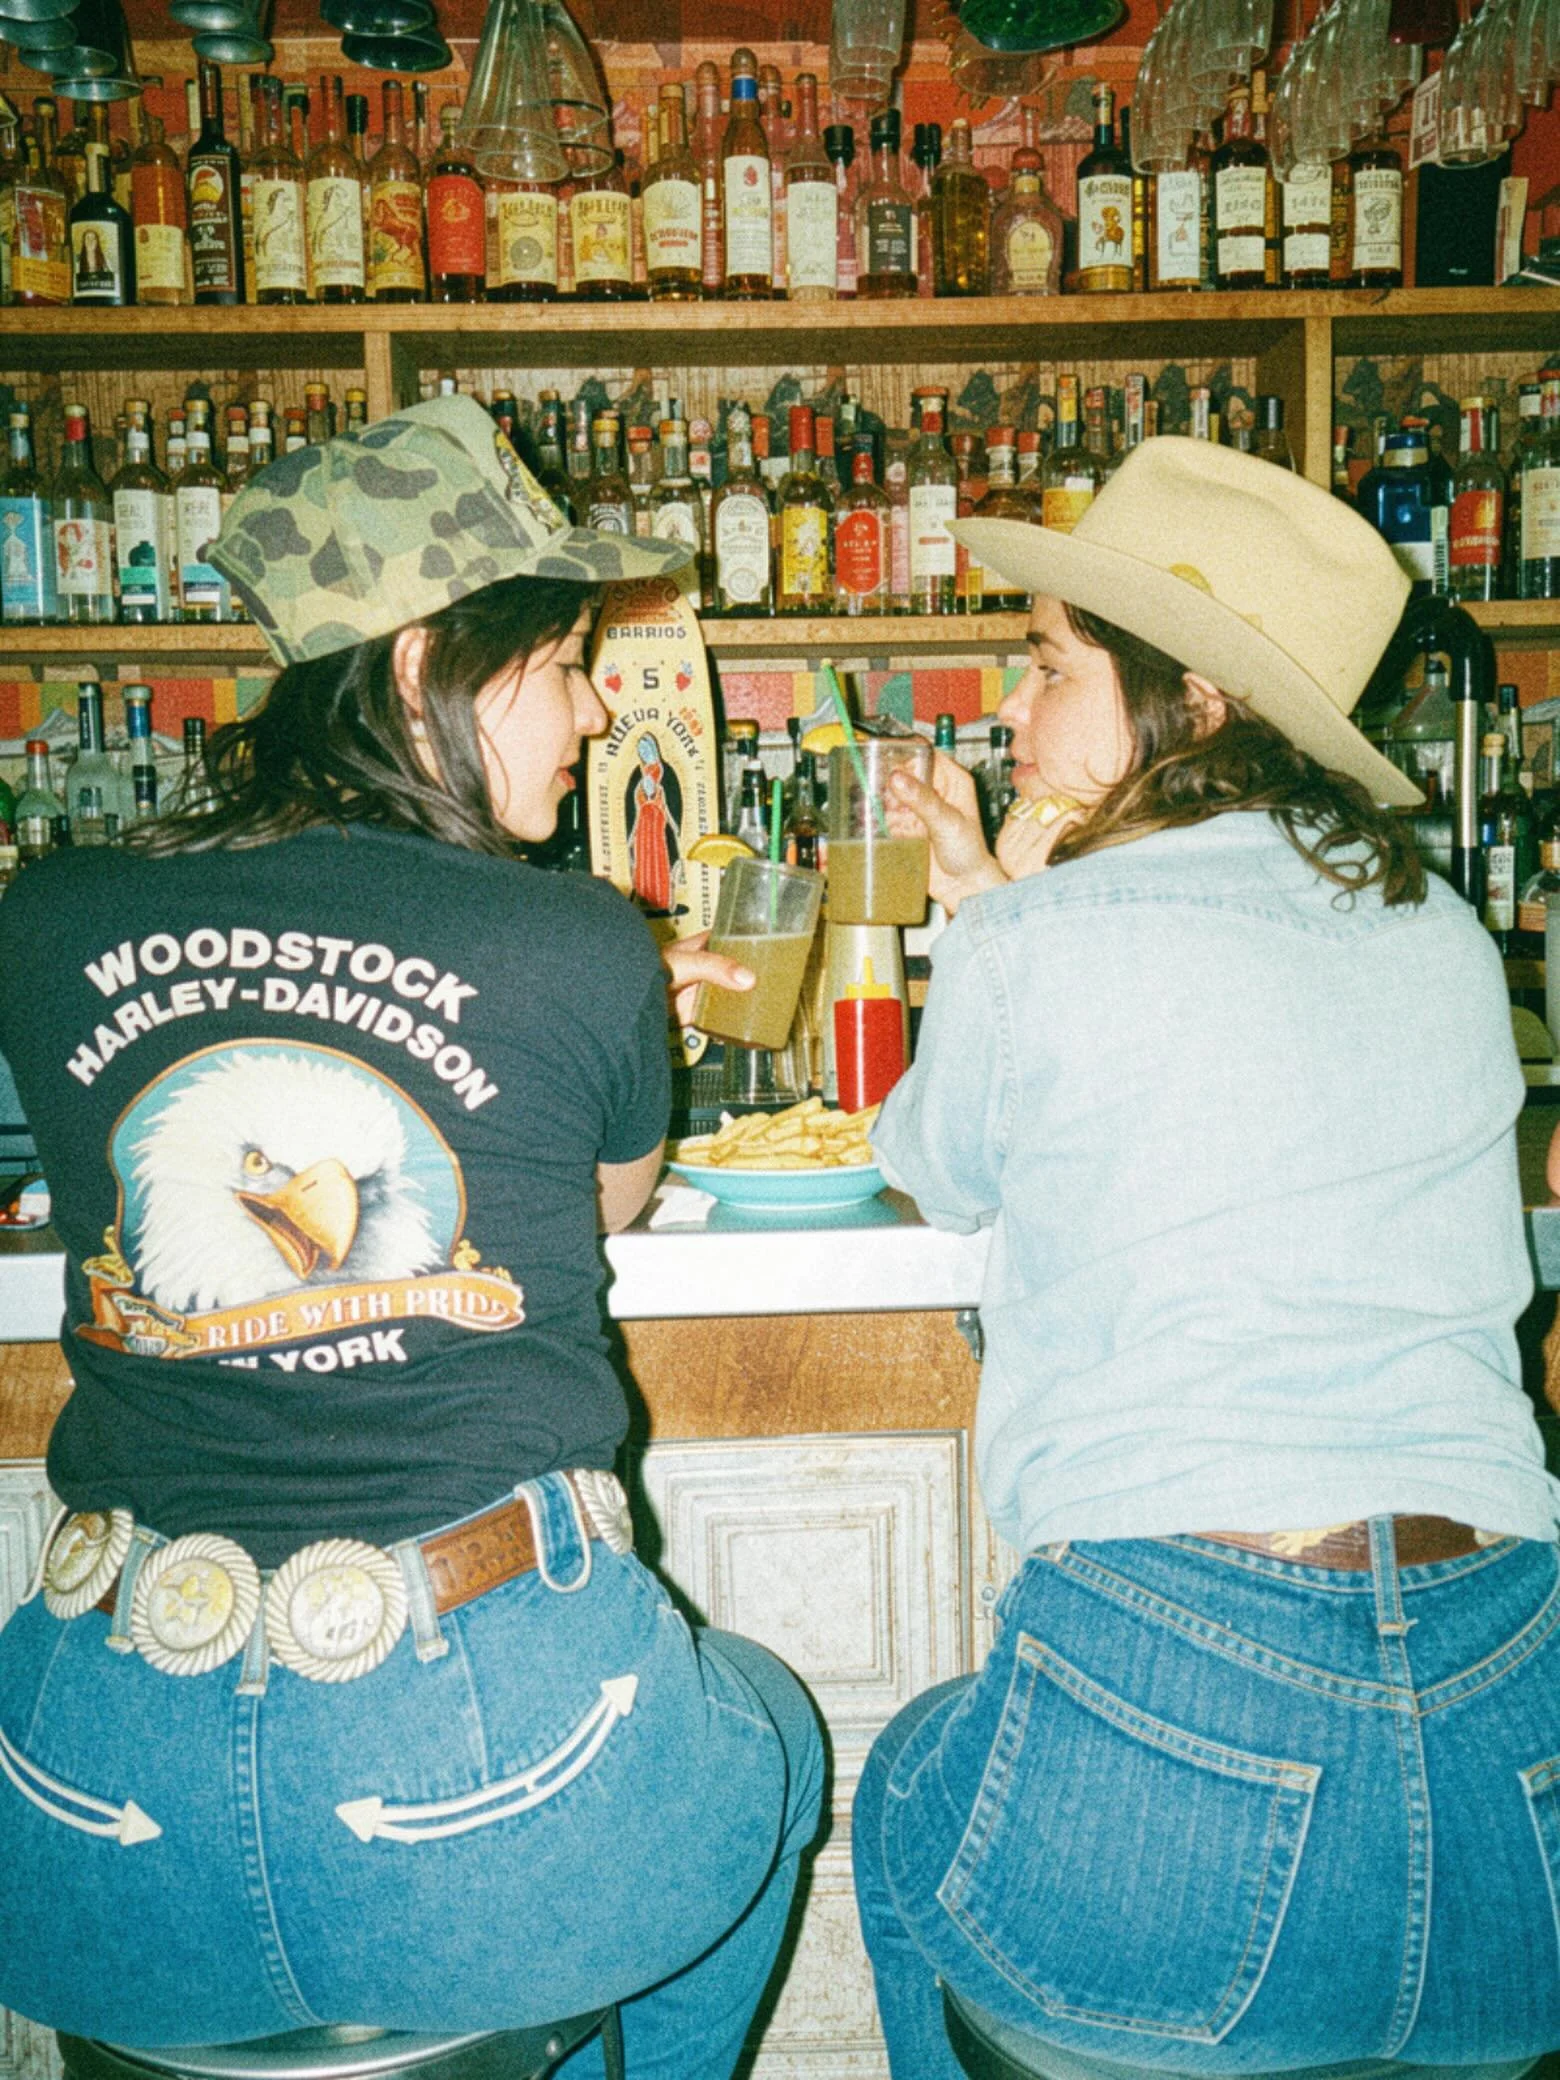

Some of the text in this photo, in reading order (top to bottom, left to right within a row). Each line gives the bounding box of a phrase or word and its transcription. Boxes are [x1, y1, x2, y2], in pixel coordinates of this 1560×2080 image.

[606, 625, 687, 640] BARRIOS
[83, 927, 479, 1024] WOODSTOCK
[65, 976, 500, 1112] HARLEY-DAVIDSON
[206, 1311, 290, 1350] RIDE
[300, 1290, 392, 1331] WITH
[269, 1328, 408, 1374] YORK
